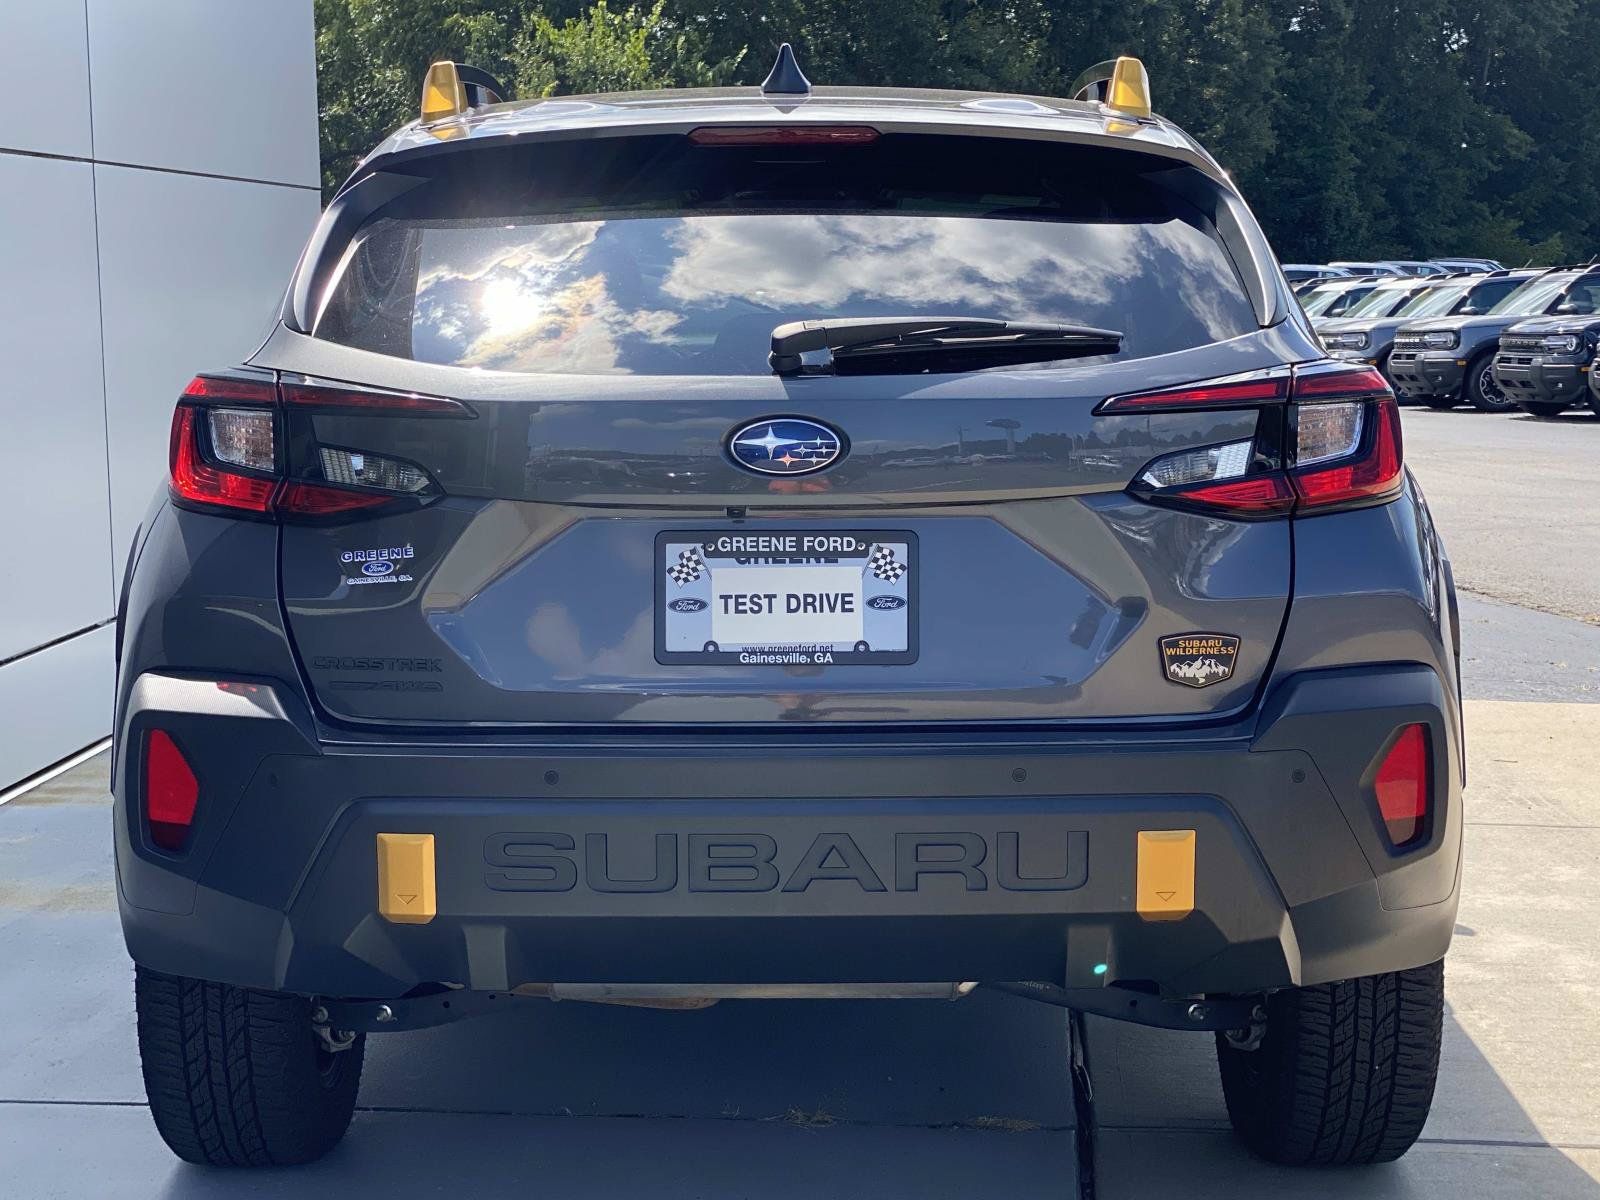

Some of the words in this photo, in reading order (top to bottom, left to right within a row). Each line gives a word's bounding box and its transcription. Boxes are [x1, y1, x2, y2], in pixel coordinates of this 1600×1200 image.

[717, 536, 797, 552] GREENE
[803, 536, 856, 552] FORD
[341, 547, 414, 562] GREENE
[368, 563, 387, 572] Ford
[675, 600, 701, 611] Ford
[719, 593, 777, 614] TEST
[786, 592, 855, 613] DRIVE
[873, 597, 899, 608] Ford
[741, 643, 834, 653] wwwgreeneford.net
[1178, 639, 1222, 648] SUBARU
[1166, 646, 1235, 655] WILDERNESS
[739, 652, 811, 664] Gainesville,
[813, 652, 834, 663] GA
[312, 655, 443, 673] CROSSTREK
[483, 831, 1090, 893] SUBARU
